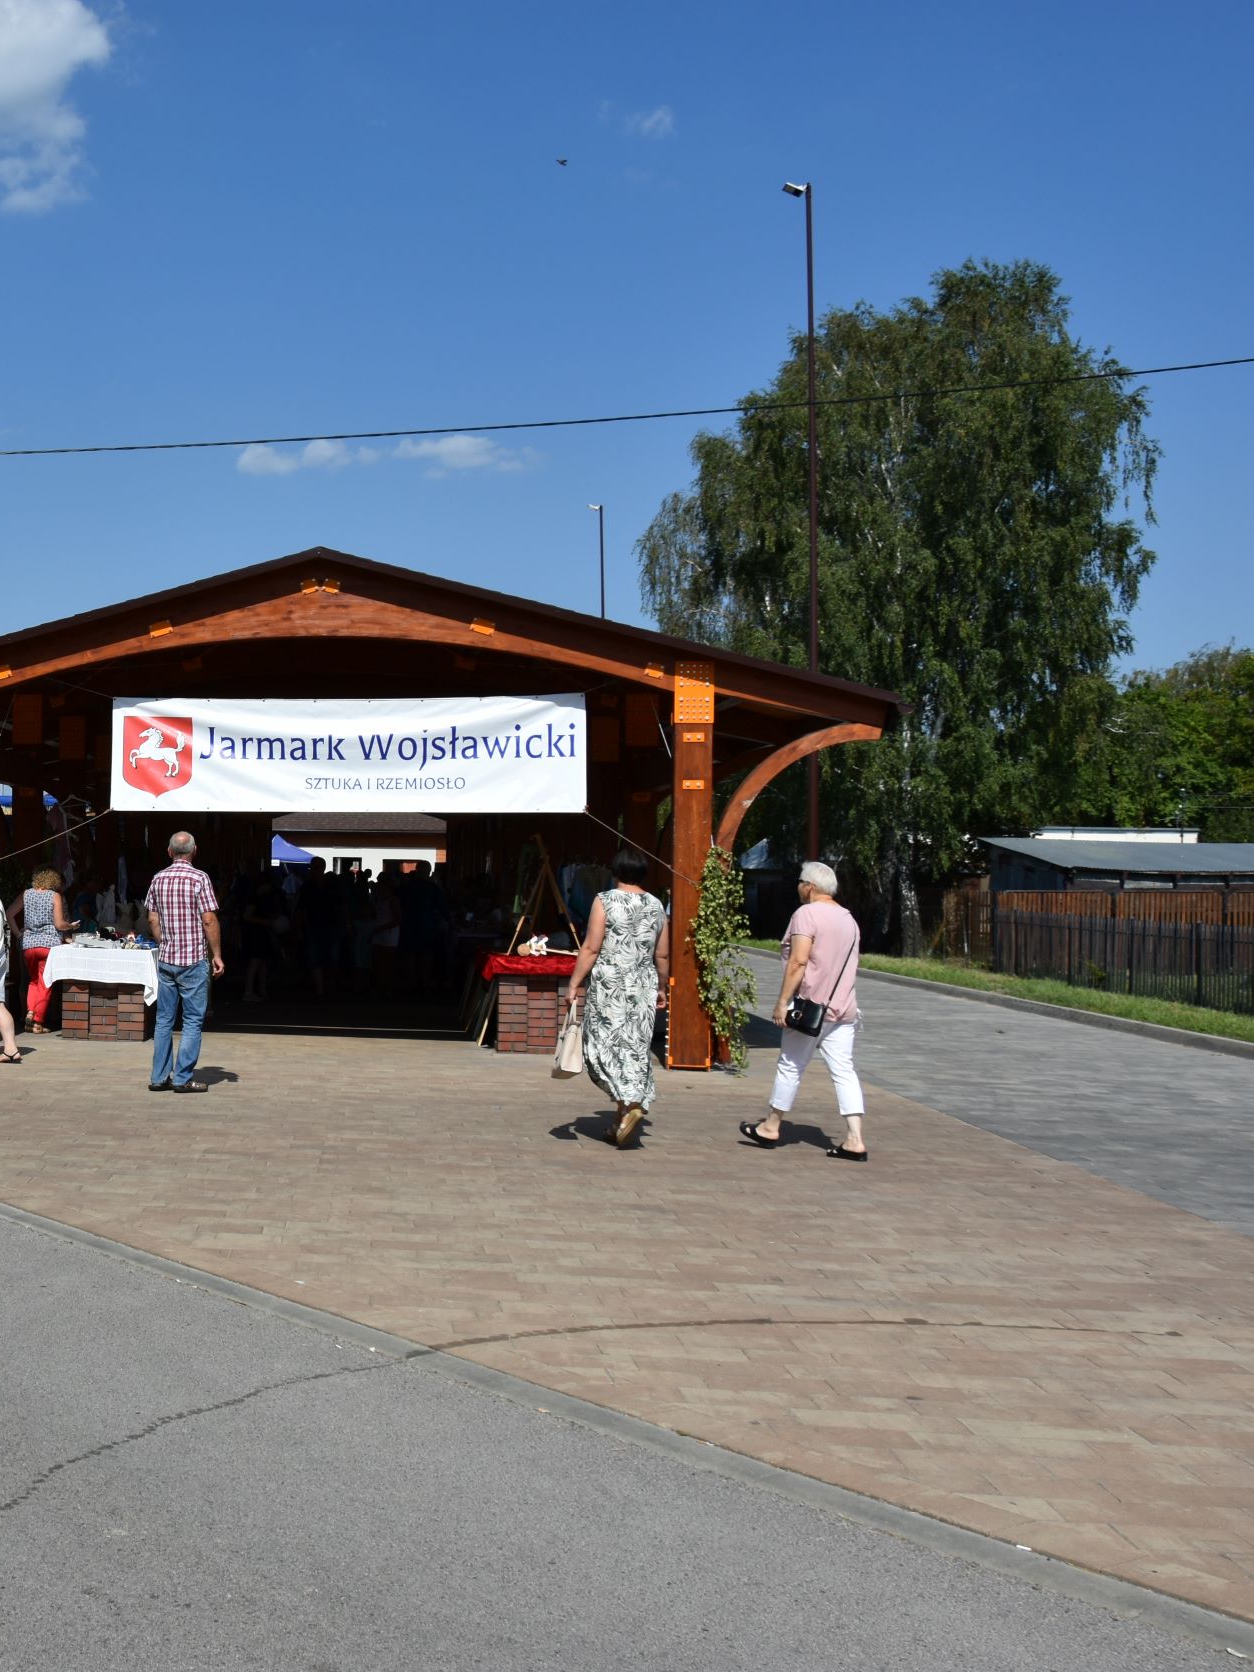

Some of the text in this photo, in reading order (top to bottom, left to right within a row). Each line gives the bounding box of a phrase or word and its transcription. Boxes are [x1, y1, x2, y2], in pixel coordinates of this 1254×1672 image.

[199, 722, 577, 771] Jarmark Wojsławicki
[305, 777, 362, 790] SZTUKA
[376, 777, 466, 790] RZEMIOSŁO
